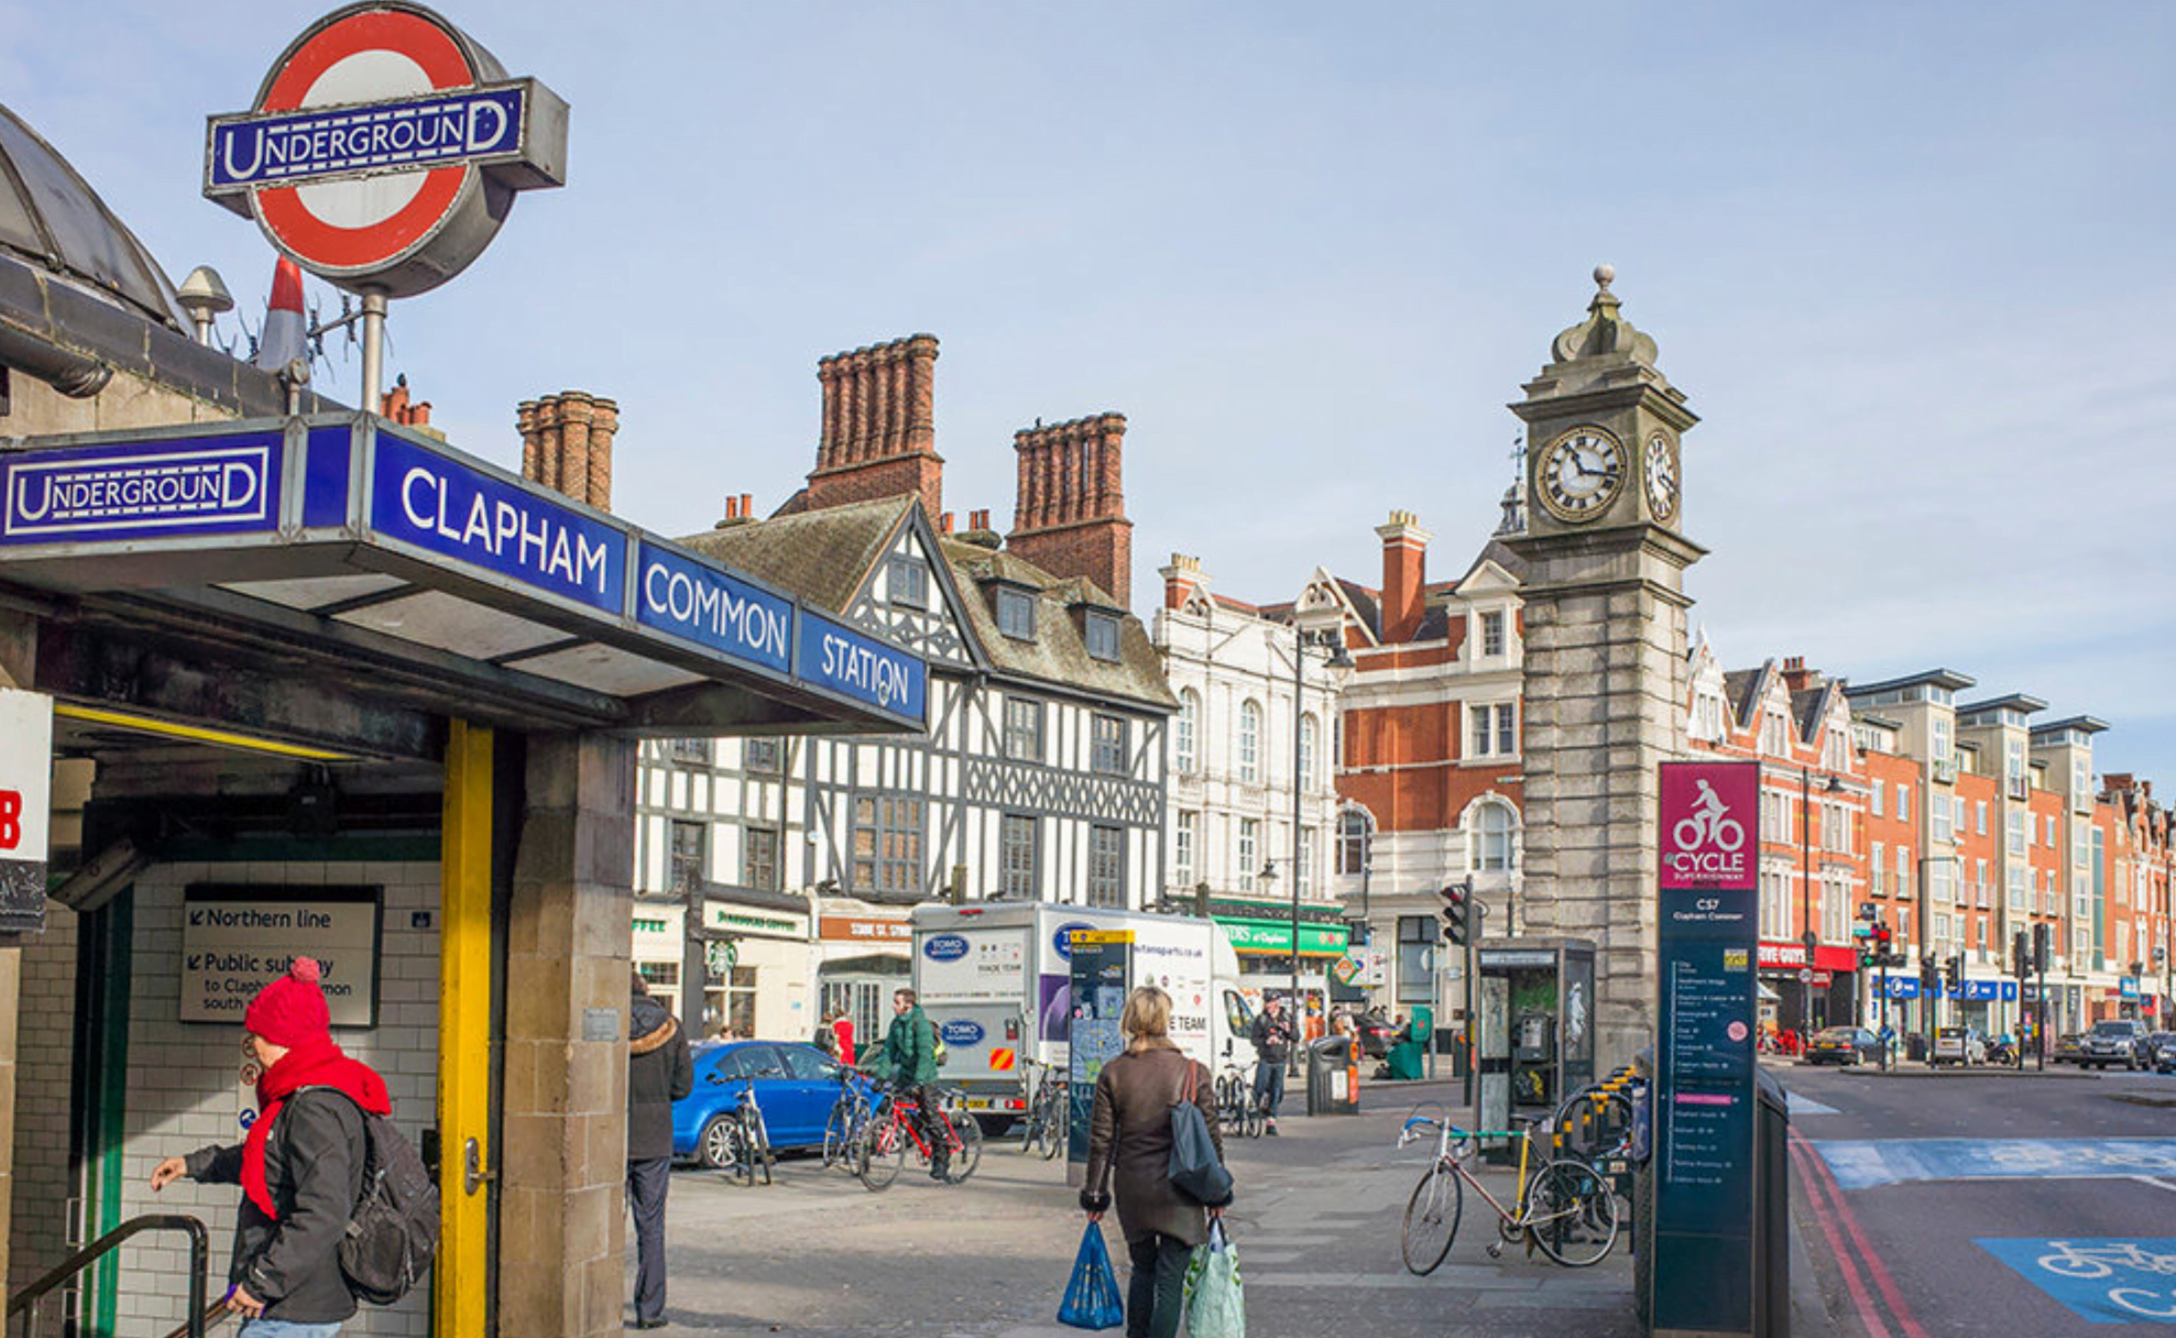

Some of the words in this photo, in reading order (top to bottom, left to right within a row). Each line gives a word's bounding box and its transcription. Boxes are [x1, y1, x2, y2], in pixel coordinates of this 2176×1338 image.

[224, 98, 506, 180] UNDERGROUND
[18, 461, 256, 521] UNDERGROUND
[401, 467, 607, 593] CLAPHAM
[645, 563, 786, 659] COMMON
[822, 634, 909, 704] STATION
[1673, 852, 1744, 872] CYCLE
[207, 909, 291, 928] Northern
[297, 910, 331, 928] line
[632, 919, 667, 932] FFEE
[205, 953, 259, 972] Public
[265, 955, 334, 978] suby
[205, 980, 220, 991] to
[224, 978, 266, 994] Claph
[321, 984, 351, 996] mon
[204, 999, 243, 1010] south
[1179, 1016, 1206, 1031] TEAM
